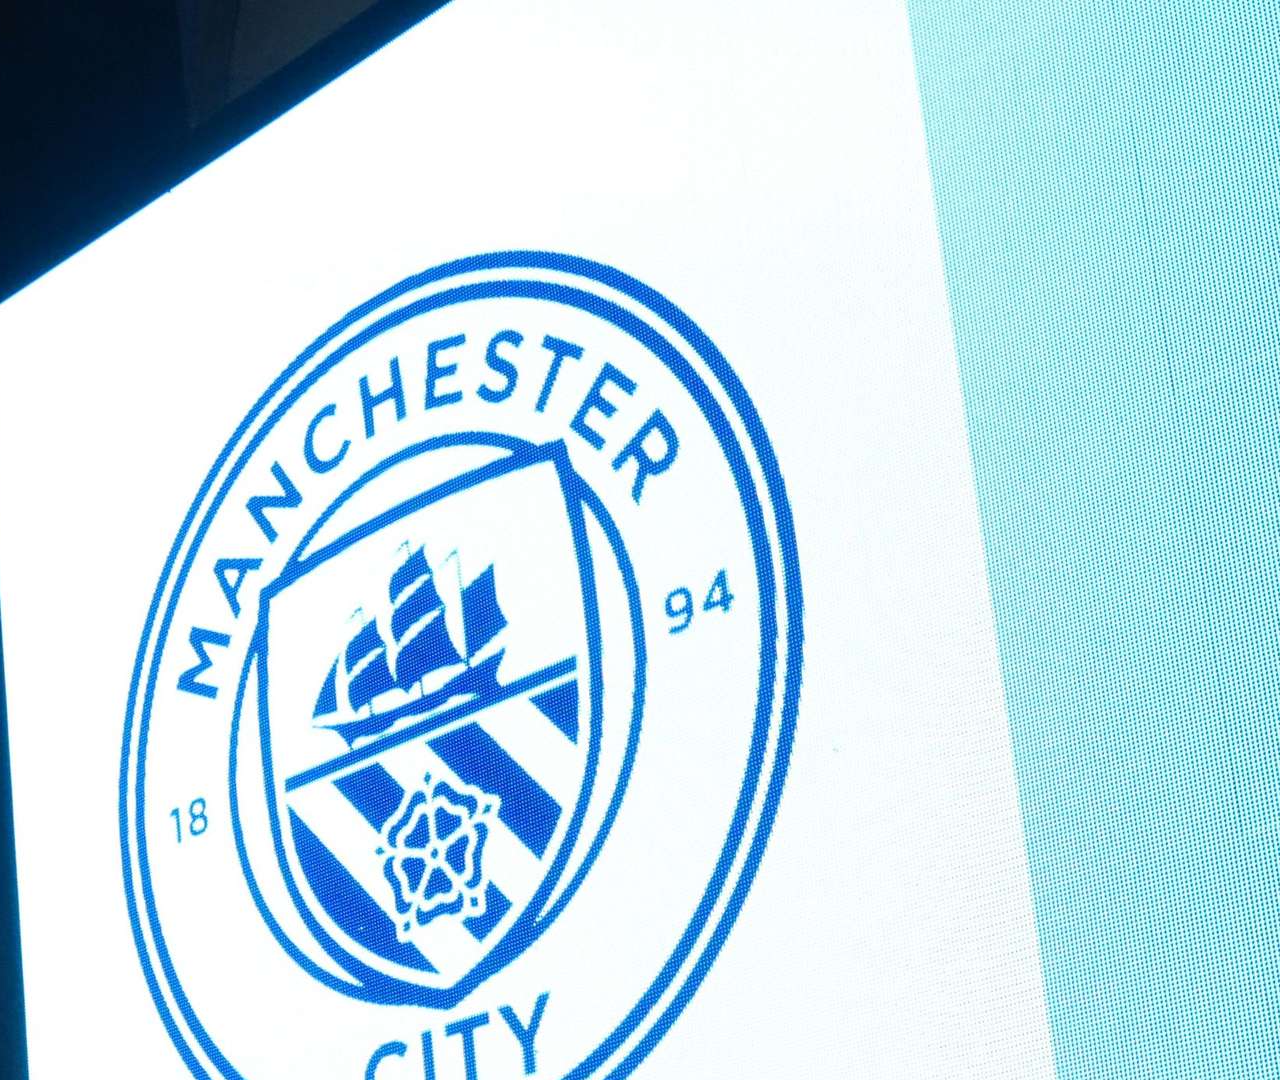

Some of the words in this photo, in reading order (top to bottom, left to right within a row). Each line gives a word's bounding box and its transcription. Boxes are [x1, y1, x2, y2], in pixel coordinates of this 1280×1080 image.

[176, 329, 679, 700] MANCHESTER
[664, 568, 734, 634] 94
[168, 798, 209, 845] 18
